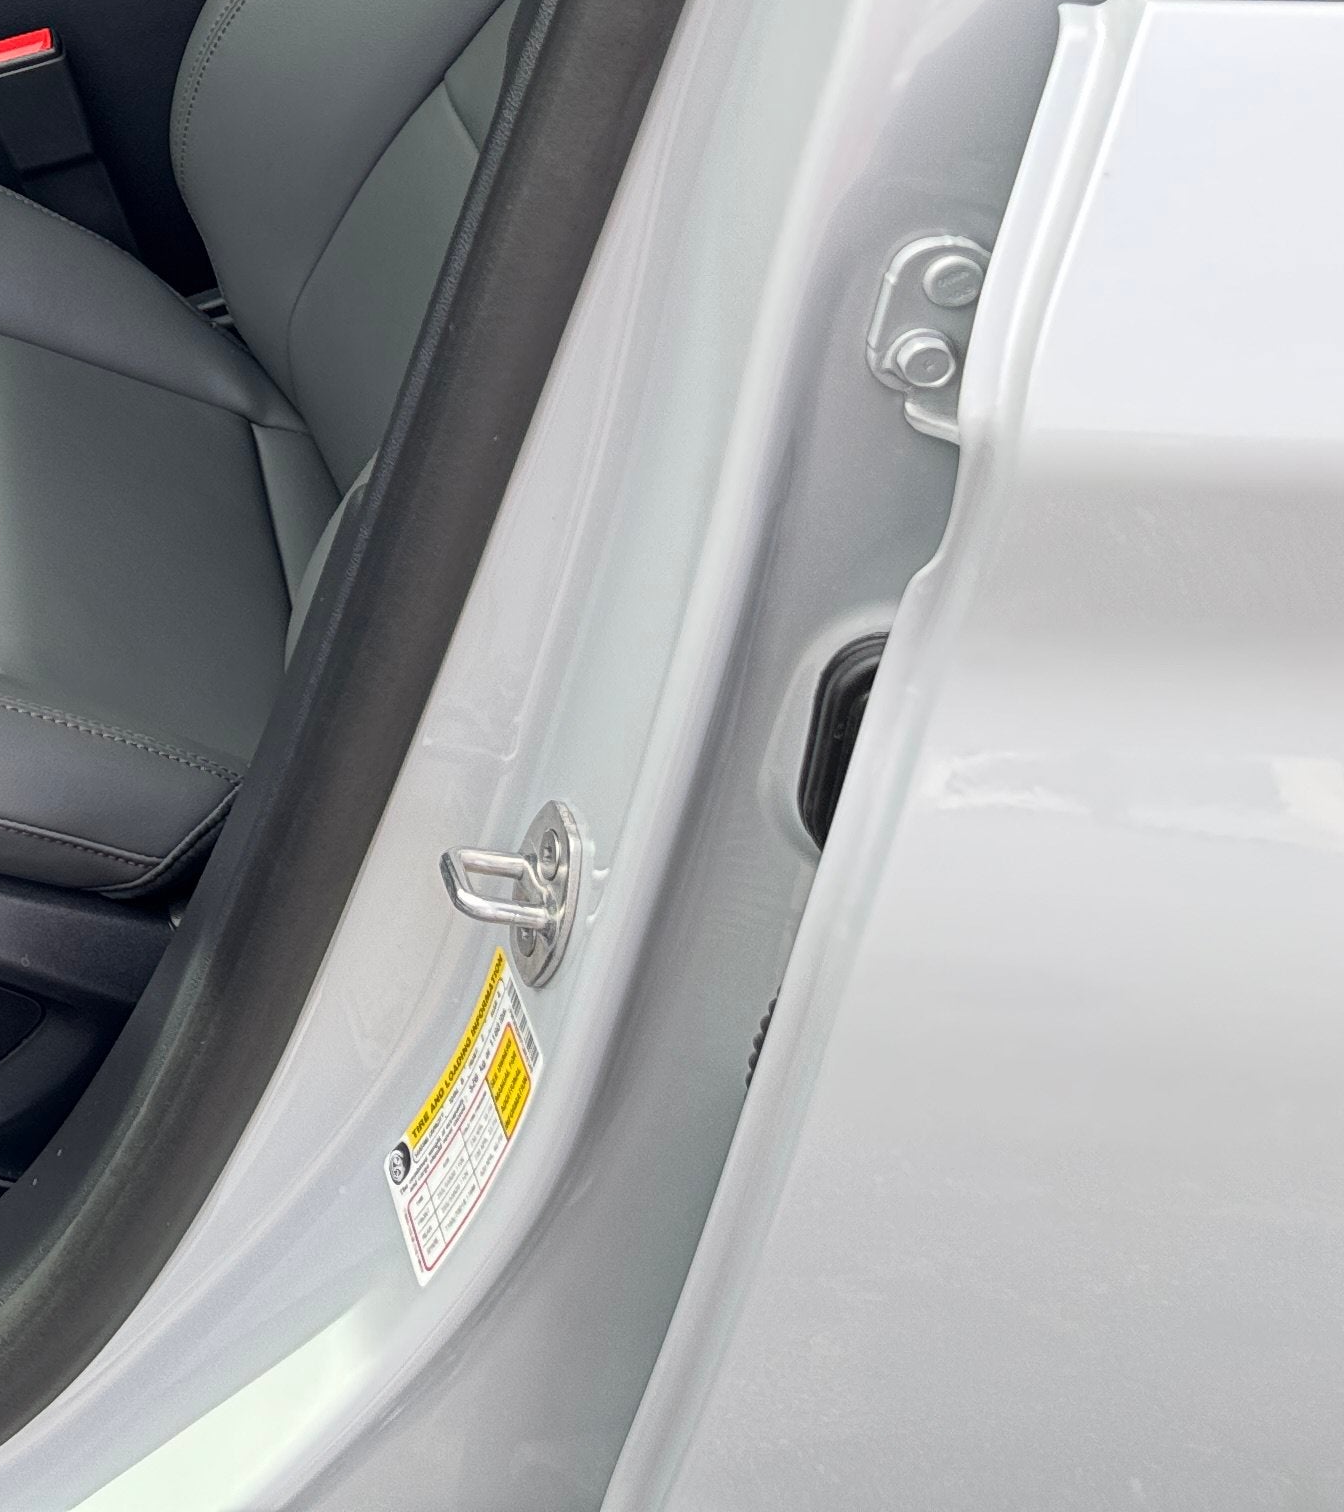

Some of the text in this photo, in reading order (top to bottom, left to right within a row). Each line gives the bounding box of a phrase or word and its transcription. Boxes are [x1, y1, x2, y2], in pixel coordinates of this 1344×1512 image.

[411, 1110, 429, 1140] TIRE
[428, 1084, 444, 1114] AND
[443, 1035, 471, 1090] LOADING
[470, 952, 503, 1037] INFORMATION
